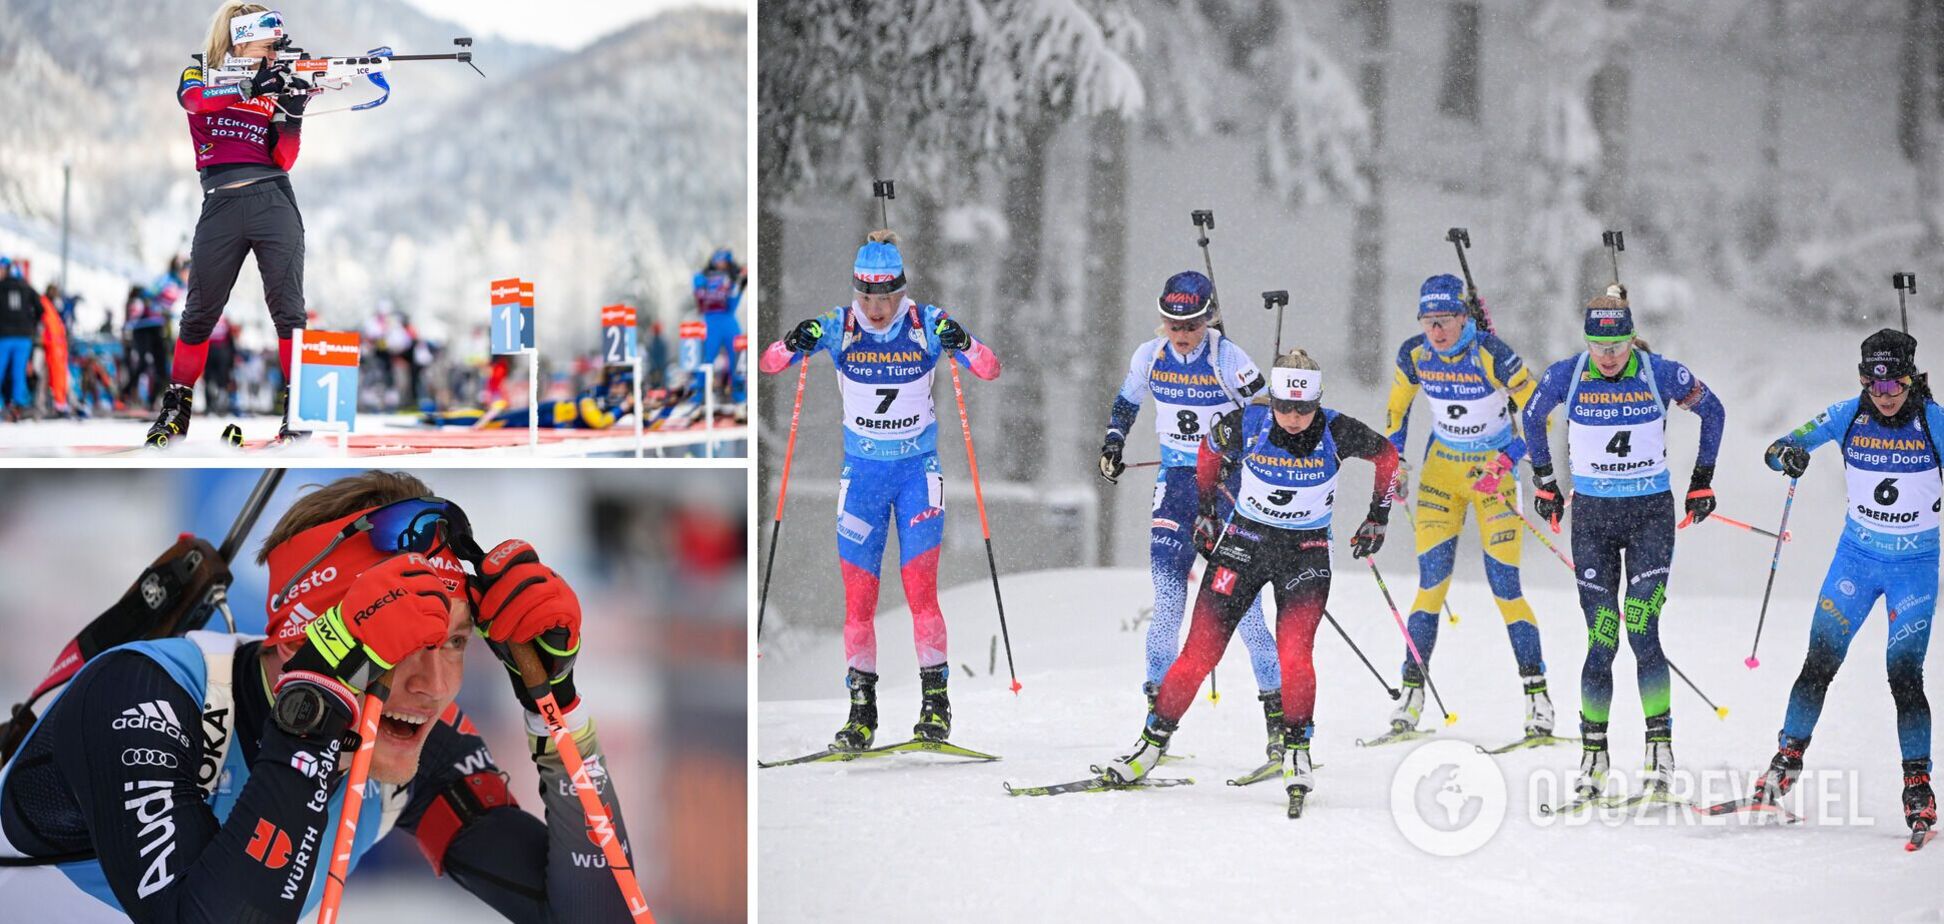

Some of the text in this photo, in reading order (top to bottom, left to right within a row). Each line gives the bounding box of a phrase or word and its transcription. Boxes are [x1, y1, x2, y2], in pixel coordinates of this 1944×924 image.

[206, 117, 268, 135] T. ECKHOFF
[211, 129, 265, 145] 2021/22
[500, 306, 511, 350] 1
[607, 326, 620, 362] 2
[848, 364, 922, 377] Tore Türen
[1286, 375, 1308, 388] ice
[1452, 385, 1485, 395] Türen
[317, 371, 339, 424] 1
[874, 389, 899, 414] 7
[1188, 387, 1224, 398] Doors
[1575, 405, 1658, 419] Garage Doors
[856, 414, 920, 430] OBERHOF
[1177, 409, 1200, 434] 8
[1605, 431, 1632, 457] 4
[1591, 459, 1655, 471] OBERHOF
[1847, 447, 1930, 465] Garage Doors
[1287, 470, 1325, 481] Türen
[1267, 489, 1298, 506] 5
[1874, 478, 1899, 506] 6
[1857, 505, 1919, 523] OBERHOF
[112, 714, 190, 748] adidas
[306, 738, 341, 813] tectake
[125, 780, 176, 900] Audi
